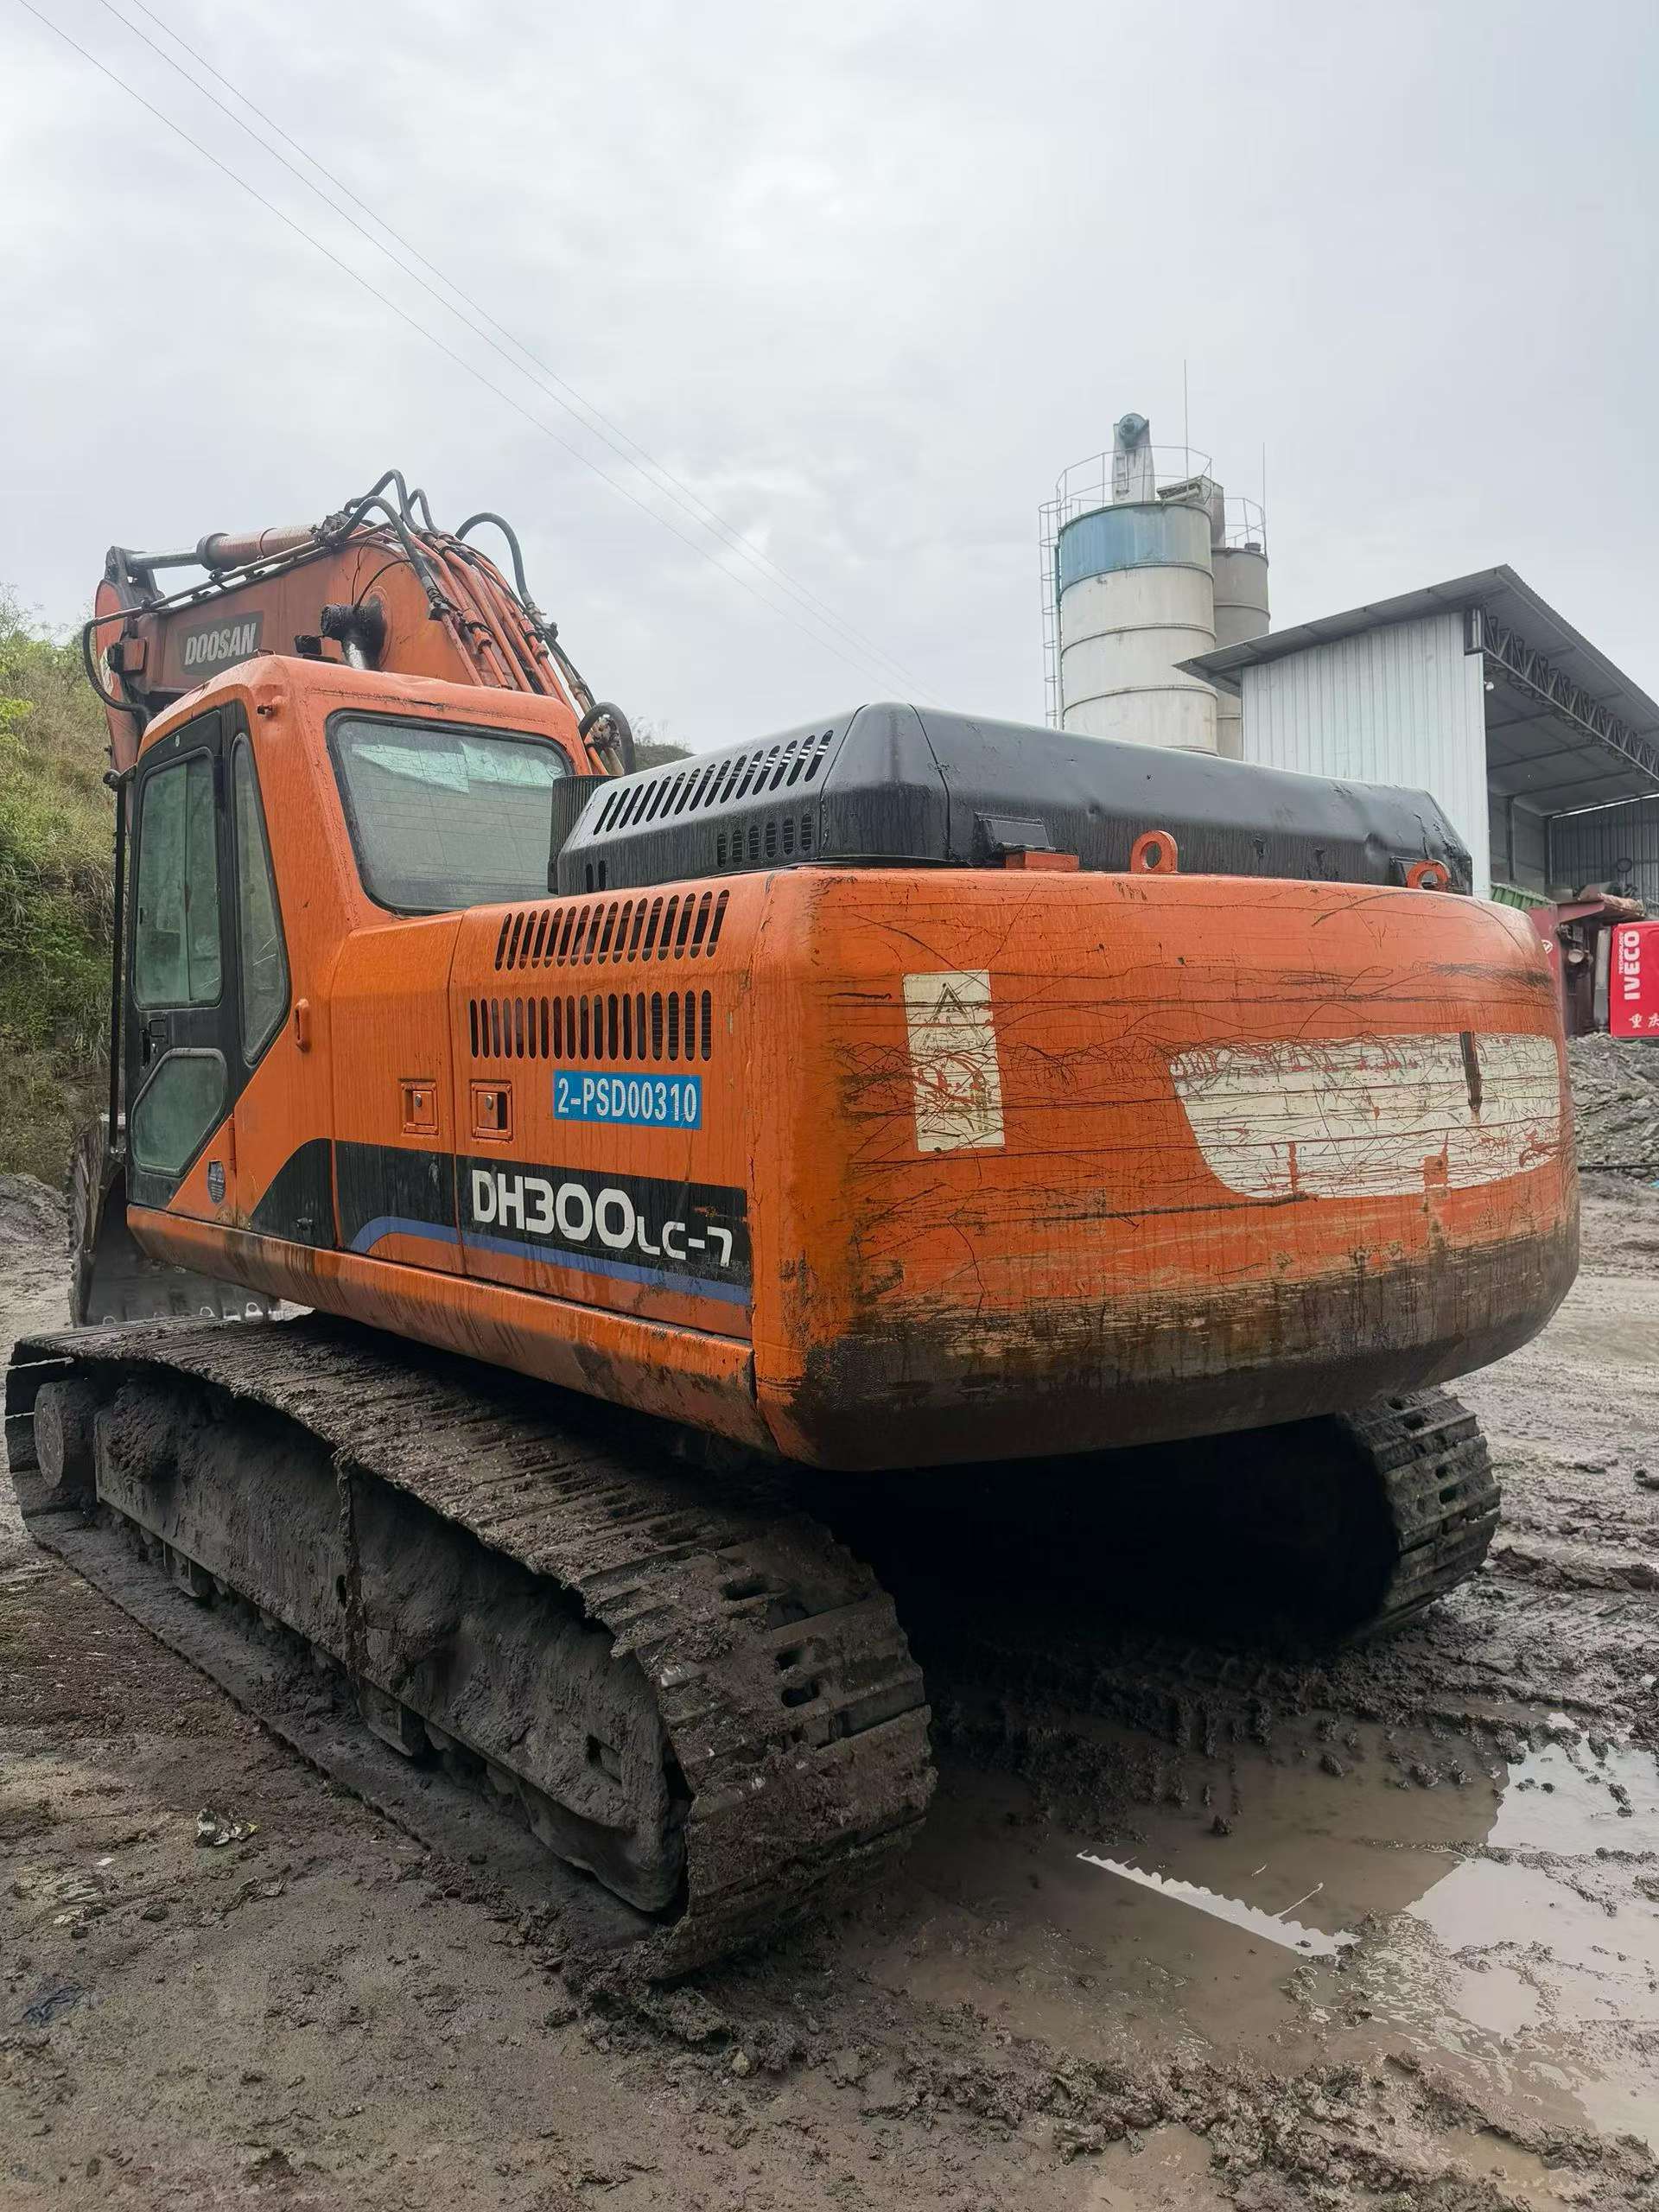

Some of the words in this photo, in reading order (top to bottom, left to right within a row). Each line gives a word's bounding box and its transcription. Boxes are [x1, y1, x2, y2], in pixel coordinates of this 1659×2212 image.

[184, 622, 257, 665] DOOSAN
[1624, 931, 1640, 1001] IVECO
[558, 1077, 698, 1122] 2-PSD00310
